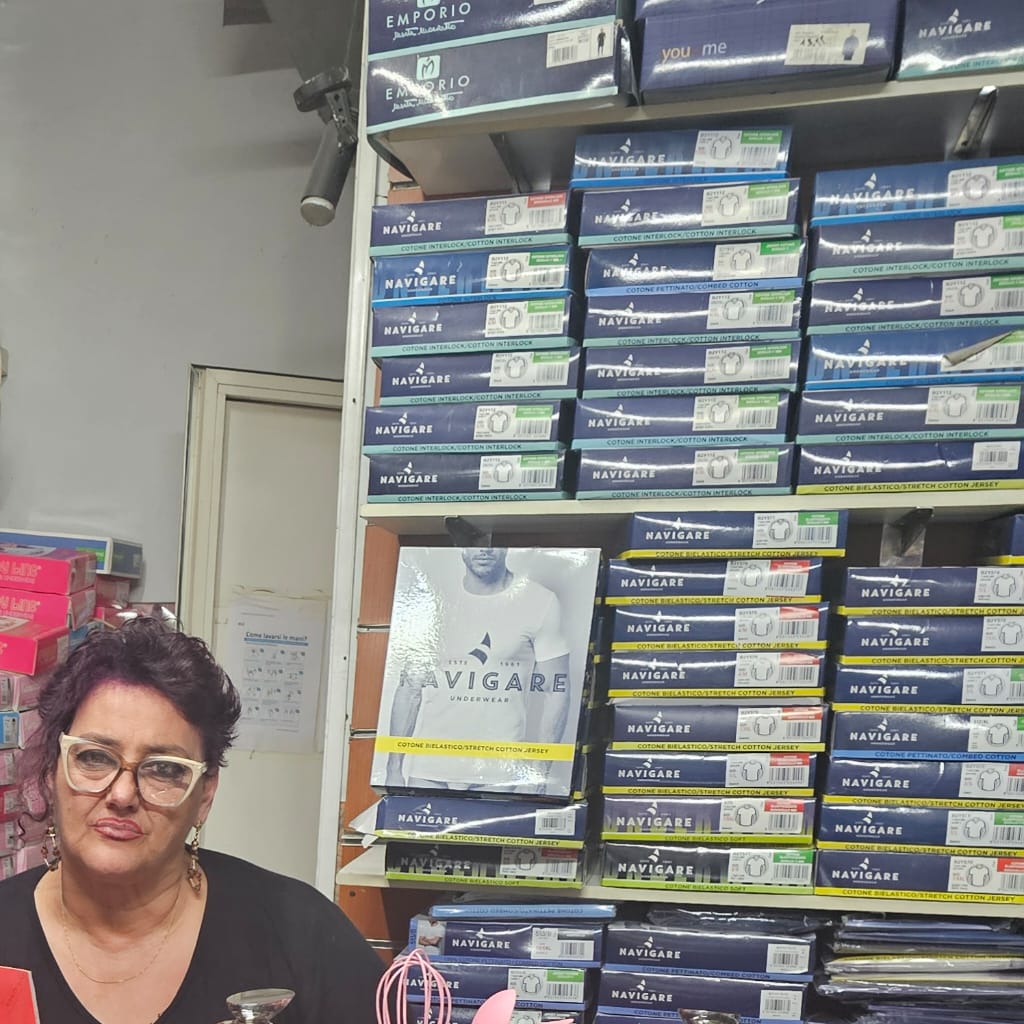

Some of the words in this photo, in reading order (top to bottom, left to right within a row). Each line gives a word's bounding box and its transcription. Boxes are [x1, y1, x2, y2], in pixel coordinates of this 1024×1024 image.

[387, 2, 470, 28] EMPORIO
[919, 21, 991, 39] NAVIGARE
[662, 45, 691, 64] you
[702, 42, 727, 55] me
[386, 75, 469, 100] EMORIO
[383, 222, 442, 234] NAVIGARE
[385, 275, 456, 289] NAVIGARE
[598, 316, 661, 326] NAVIGARE
[384, 324, 443, 335] NAVIGARE
[392, 375, 451, 385] NAVIGARE
[588, 417, 650, 427] NAVIGARE
[815, 413, 883, 423] NAVIGARE
[376, 425, 432, 434] NAVIGARE
[593, 470, 655, 479] NAVIGARE
[814, 465, 882, 475] NAVIGARE
[380, 475, 438, 484] NAVIGARE
[646, 531, 710, 540] NAVIGARE
[621, 578, 684, 587] NAVIGARE
[861, 589, 930, 597] NAVIGARE
[627, 624, 690, 632] NAVIGARE
[861, 638, 929, 646] NAVIGARE
[623, 671, 685, 680] NAVIGARE
[400, 670, 567, 692] AVIGARE
[850, 686, 918, 694] NAVIGARE
[628, 725, 691, 733] NAVIGARE
[850, 732, 918, 741] NAVIGARE
[618, 769, 680, 778] NAVIGARE
[842, 778, 910, 788] NAVIGARE
[398, 814, 458, 825] NAVIGARE
[616, 817, 691, 827] NAVIGARE
[835, 825, 902, 834] NAVIGARE
[401, 857, 471, 869] NAVIGARE
[618, 863, 694, 875] NAVIGARE
[832, 871, 899, 880] NAVIGARE
[452, 939, 510, 949] NAVIGARE
[620, 948, 680, 959] NAVIGARE
[612, 990, 672, 1002] NAVIGARE
